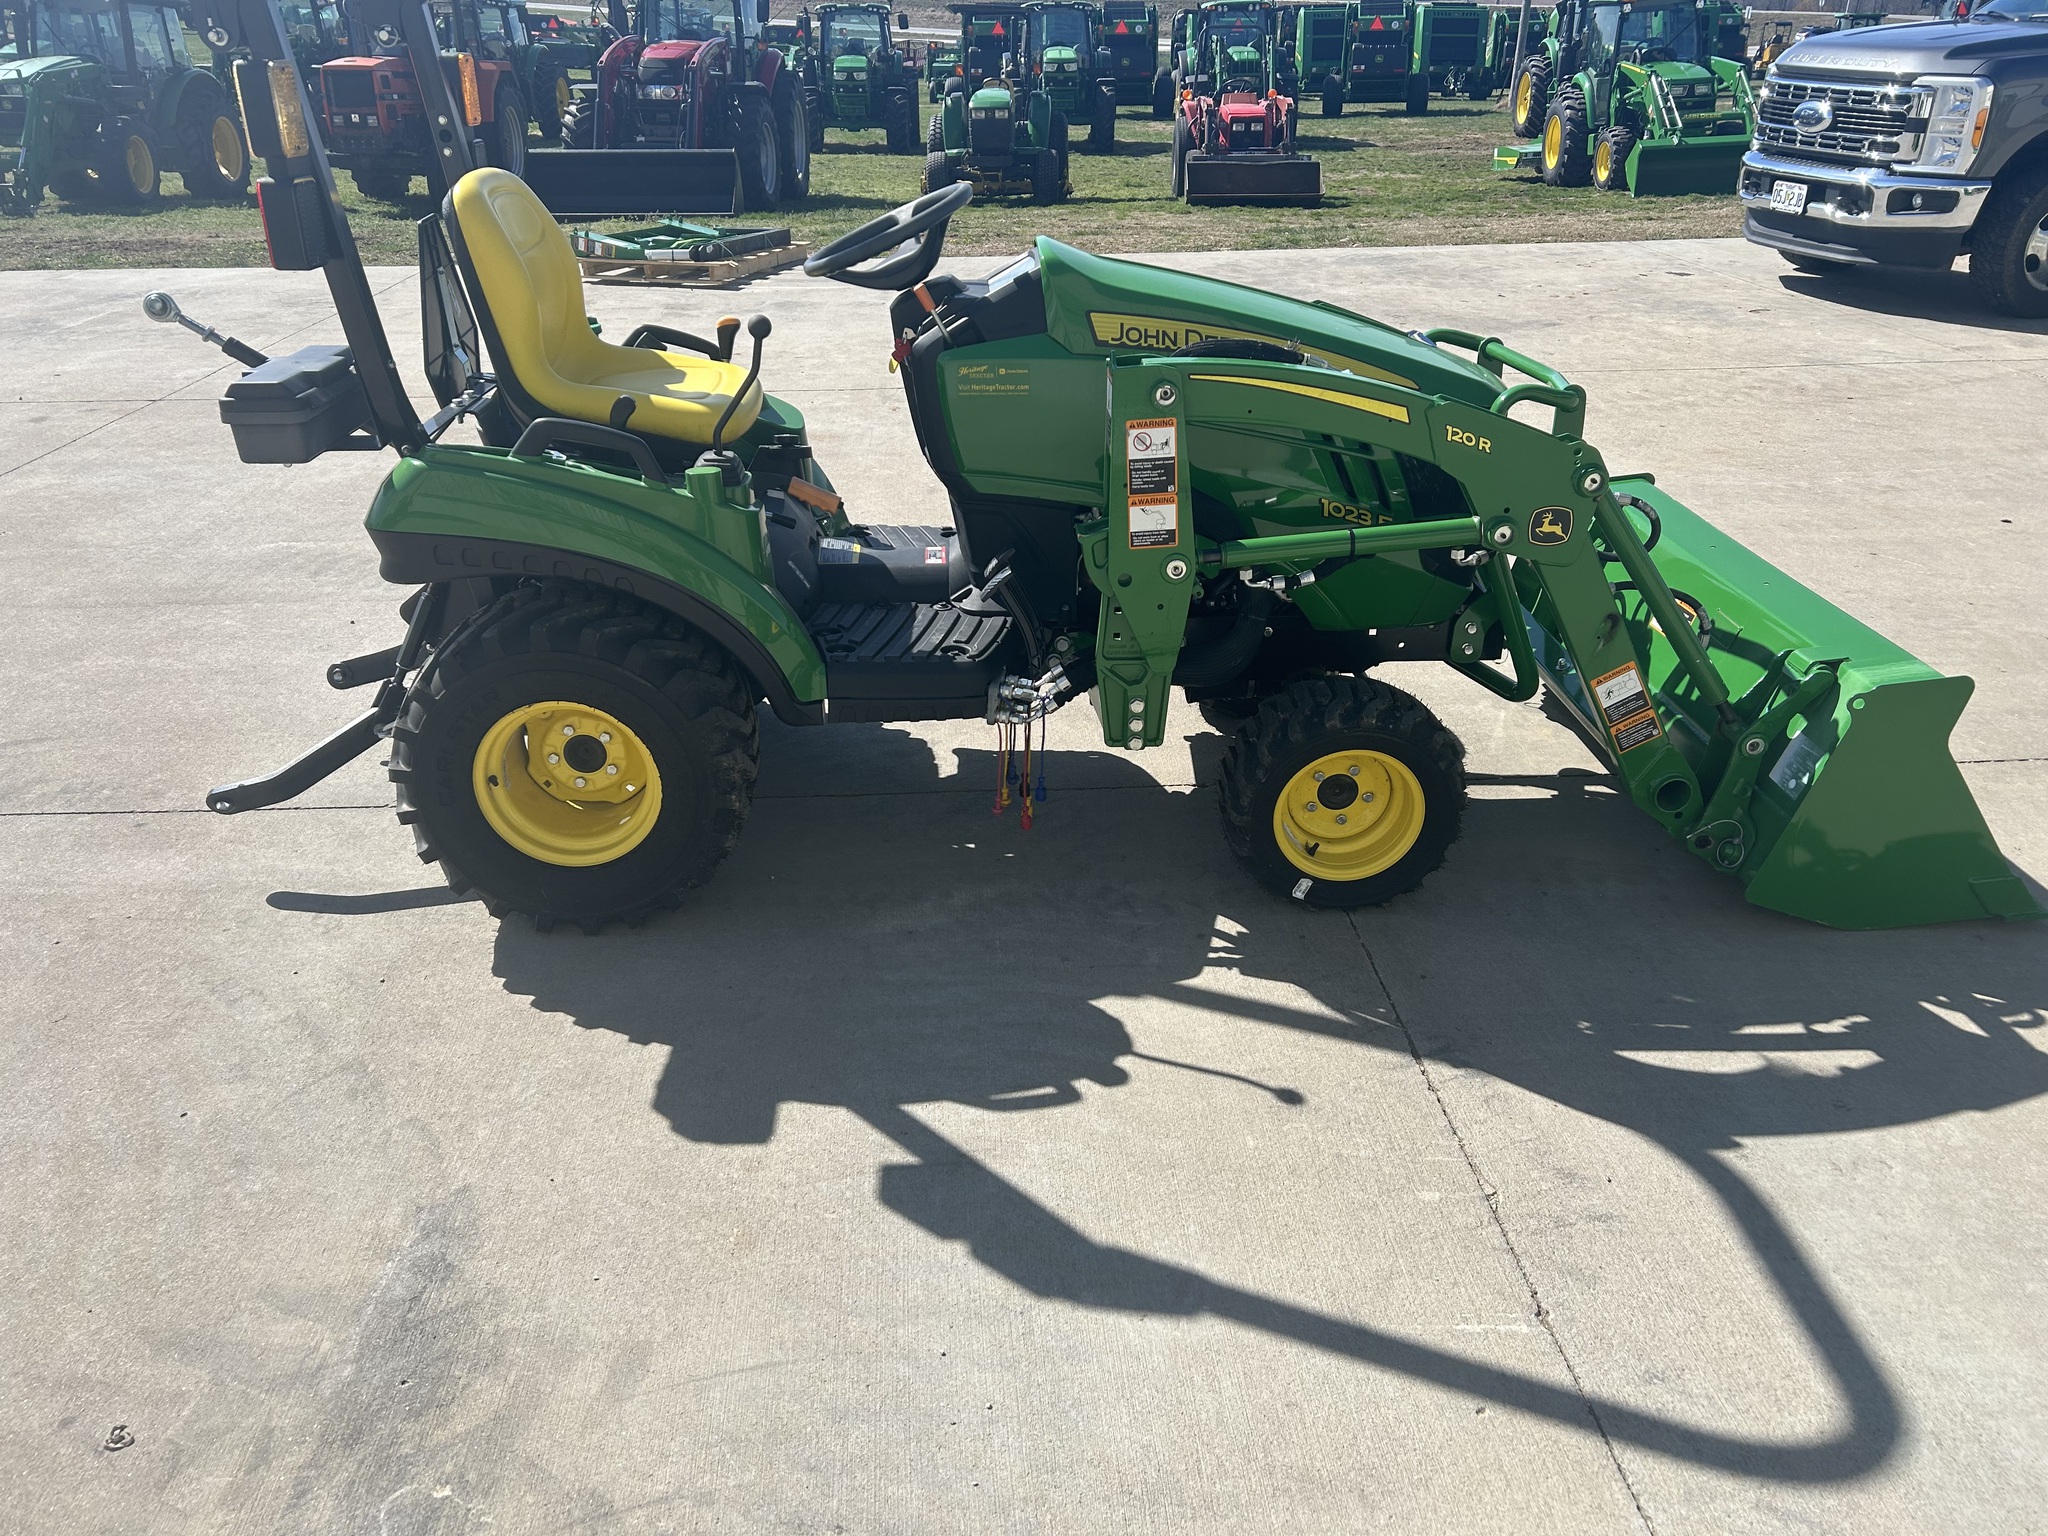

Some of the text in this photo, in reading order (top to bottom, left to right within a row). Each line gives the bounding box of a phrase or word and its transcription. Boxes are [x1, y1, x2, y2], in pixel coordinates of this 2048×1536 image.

[1111, 322, 1178, 347] JOHN
[1136, 419, 1174, 428] WARNING
[1137, 496, 1175, 505] WARNING
[1603, 665, 1631, 681] WARNING
[1623, 713, 1651, 729] WARNING
